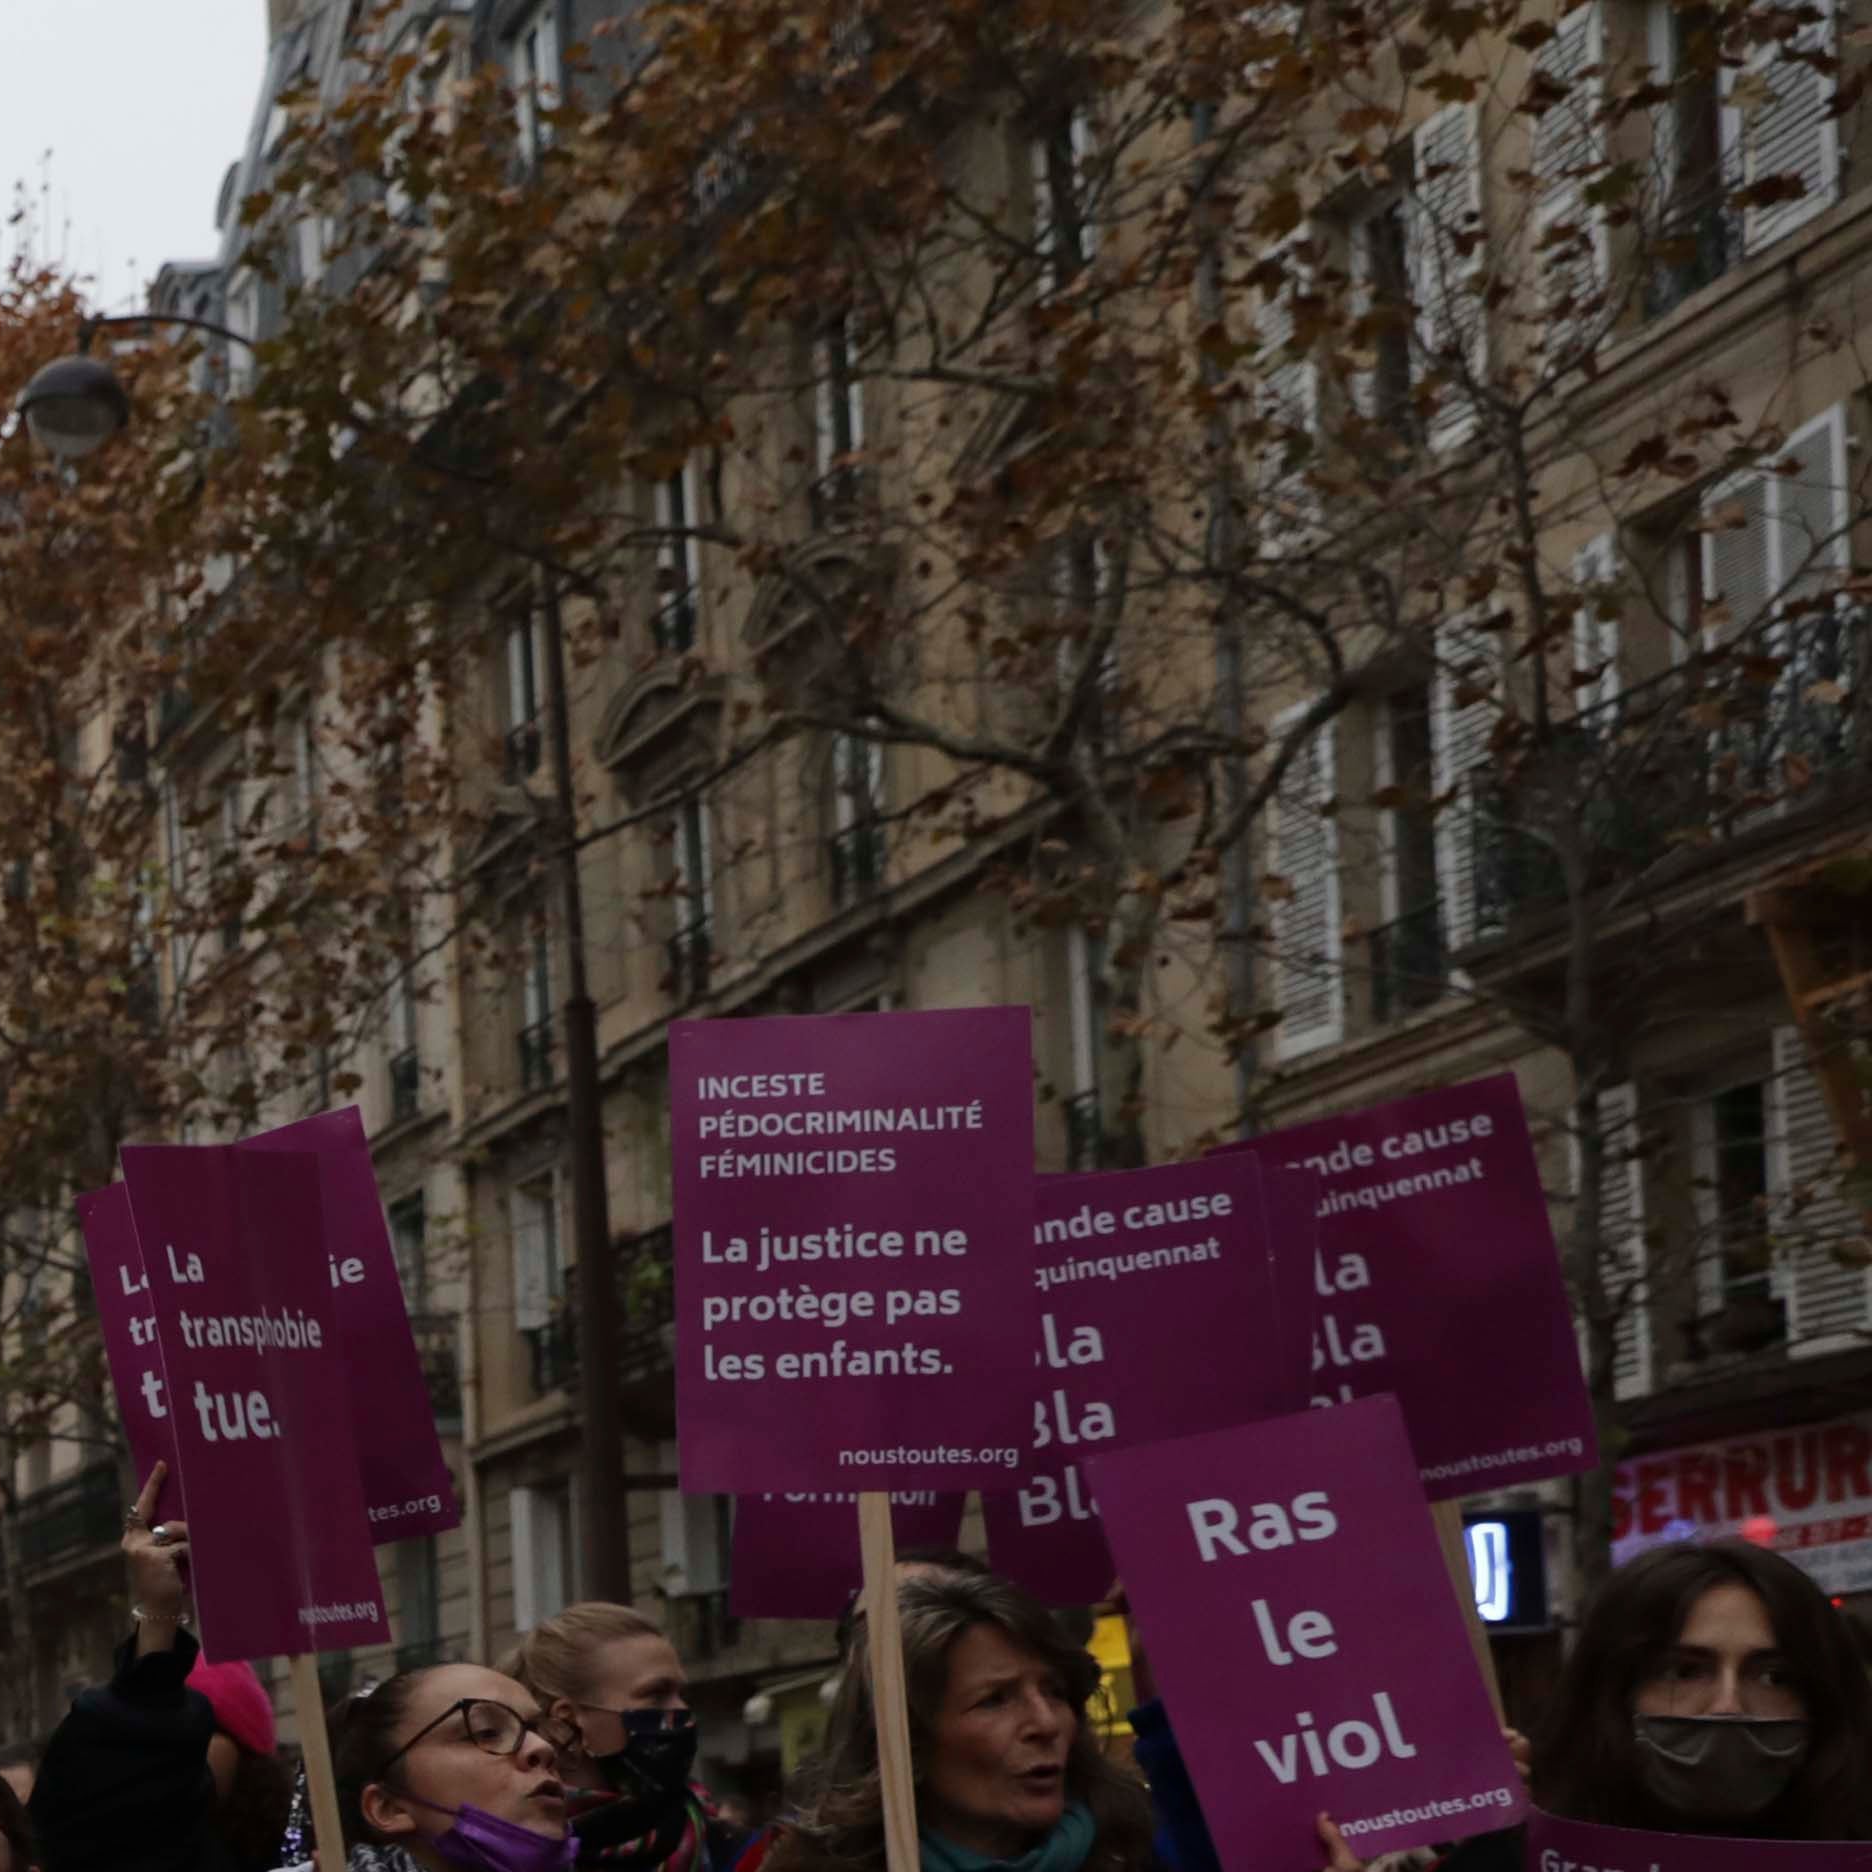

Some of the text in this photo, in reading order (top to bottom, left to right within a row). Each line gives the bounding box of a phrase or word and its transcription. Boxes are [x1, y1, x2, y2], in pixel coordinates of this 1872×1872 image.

[698, 1072, 825, 1100] INCESTE
[699, 1100, 983, 1139] PÉDOCRIMINALITÉ
[1381, 1113, 1494, 1160] cause
[700, 1148, 896, 1178] FÉMINICIDES
[1123, 1193, 1233, 1231] cause
[166, 1244, 204, 1284] La
[702, 1224, 967, 1271] La justice ne
[1314, 1248, 1372, 1298] la
[180, 1305, 322, 1355] transphobie
[703, 1286, 961, 1330] protège pas
[704, 1340, 953, 1380] les enfants.
[1034, 1312, 1105, 1369] la
[193, 1380, 281, 1441] tue.
[839, 1445, 1019, 1469] noustoutes.org
[1419, 1435, 1583, 1482] noustoutes.org
[1018, 1464, 1100, 1527] Bl
[1185, 1489, 1338, 1563] Ras
[1250, 1598, 1338, 1667] le
[1253, 1690, 1418, 1785] viol
[1339, 1786, 1512, 1837] noustoutes.org
